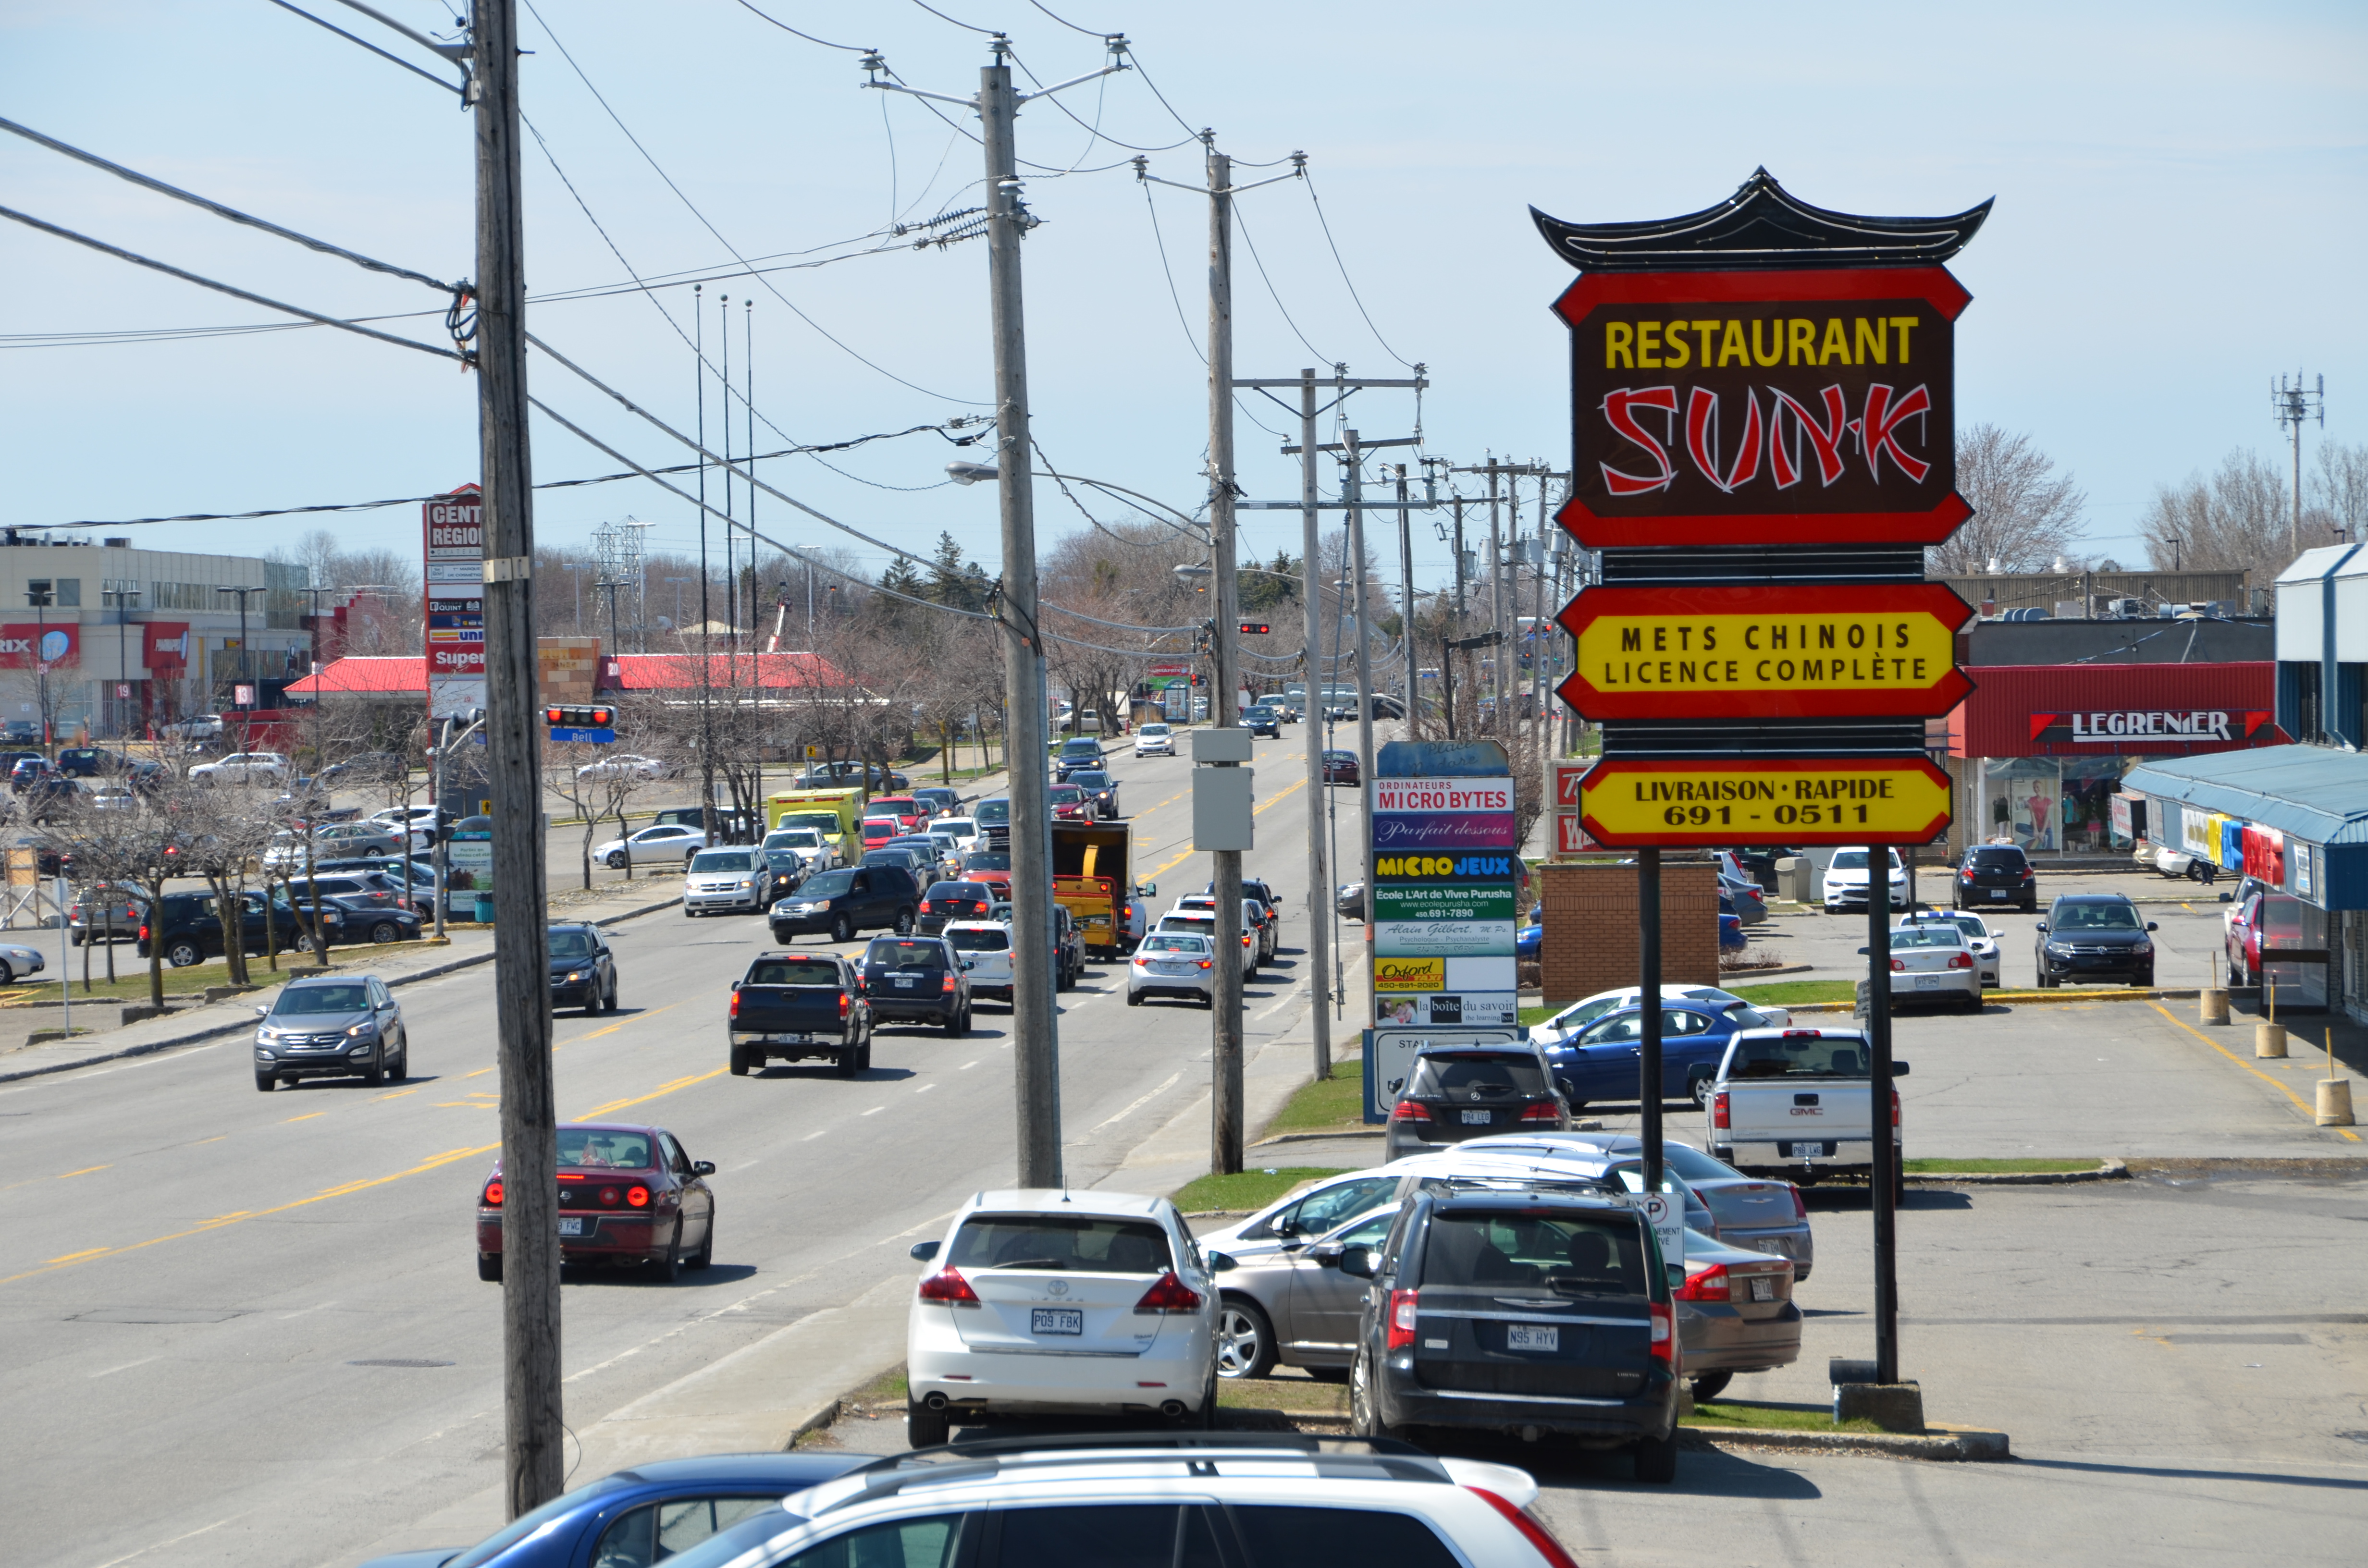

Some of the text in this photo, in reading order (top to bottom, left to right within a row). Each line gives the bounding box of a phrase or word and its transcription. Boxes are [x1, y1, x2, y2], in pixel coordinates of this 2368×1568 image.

[1605, 317, 1919, 368] RESTAURANT
[432, 506, 481, 523] CENT
[433, 525, 481, 545] RÉGIO
[1621, 623, 1910, 652] METS CHINOIS
[609, 663, 618, 675] 20
[1605, 652, 1926, 684] LICENCE COMPLÈTE
[118, 685, 128, 697] 19
[237, 687, 248, 703] 13
[2073, 711, 2232, 741] LEGRENIER
[572, 733, 592, 742] Bell
[1425, 740, 1475, 755] Place
[1379, 782, 1452, 790] ORDINATEURS
[1635, 778, 1894, 801] LIVRAISON RAPIDE
[1379, 791, 1506, 809] MICRO BYTES
[1664, 806, 1731, 826] 691
[1774, 804, 1868, 824] 0511
[1378, 821, 1508, 842] Parfait dessous
[1376, 888, 1512, 900] École L'Art de Vivre Purusha
[1400, 900, 1489, 908] www.ecolepurusha.com
[1415, 908, 1474, 918] 450.691-7890
[1384, 923, 1422, 934] Alain
[1381, 961, 1433, 980] Oxford
[1419, 1000, 1514, 1012] la boîte du savoir
[1399, 1040, 1421, 1048] STA
[1790, 1107, 1824, 1115] GMC
[567, 1222, 580, 1230] FWC
[1654, 1227, 1680, 1236] NEMENT
[1060, 1316, 1079, 1328] FBK
[1510, 1331, 1555, 1345] N95 HYV
